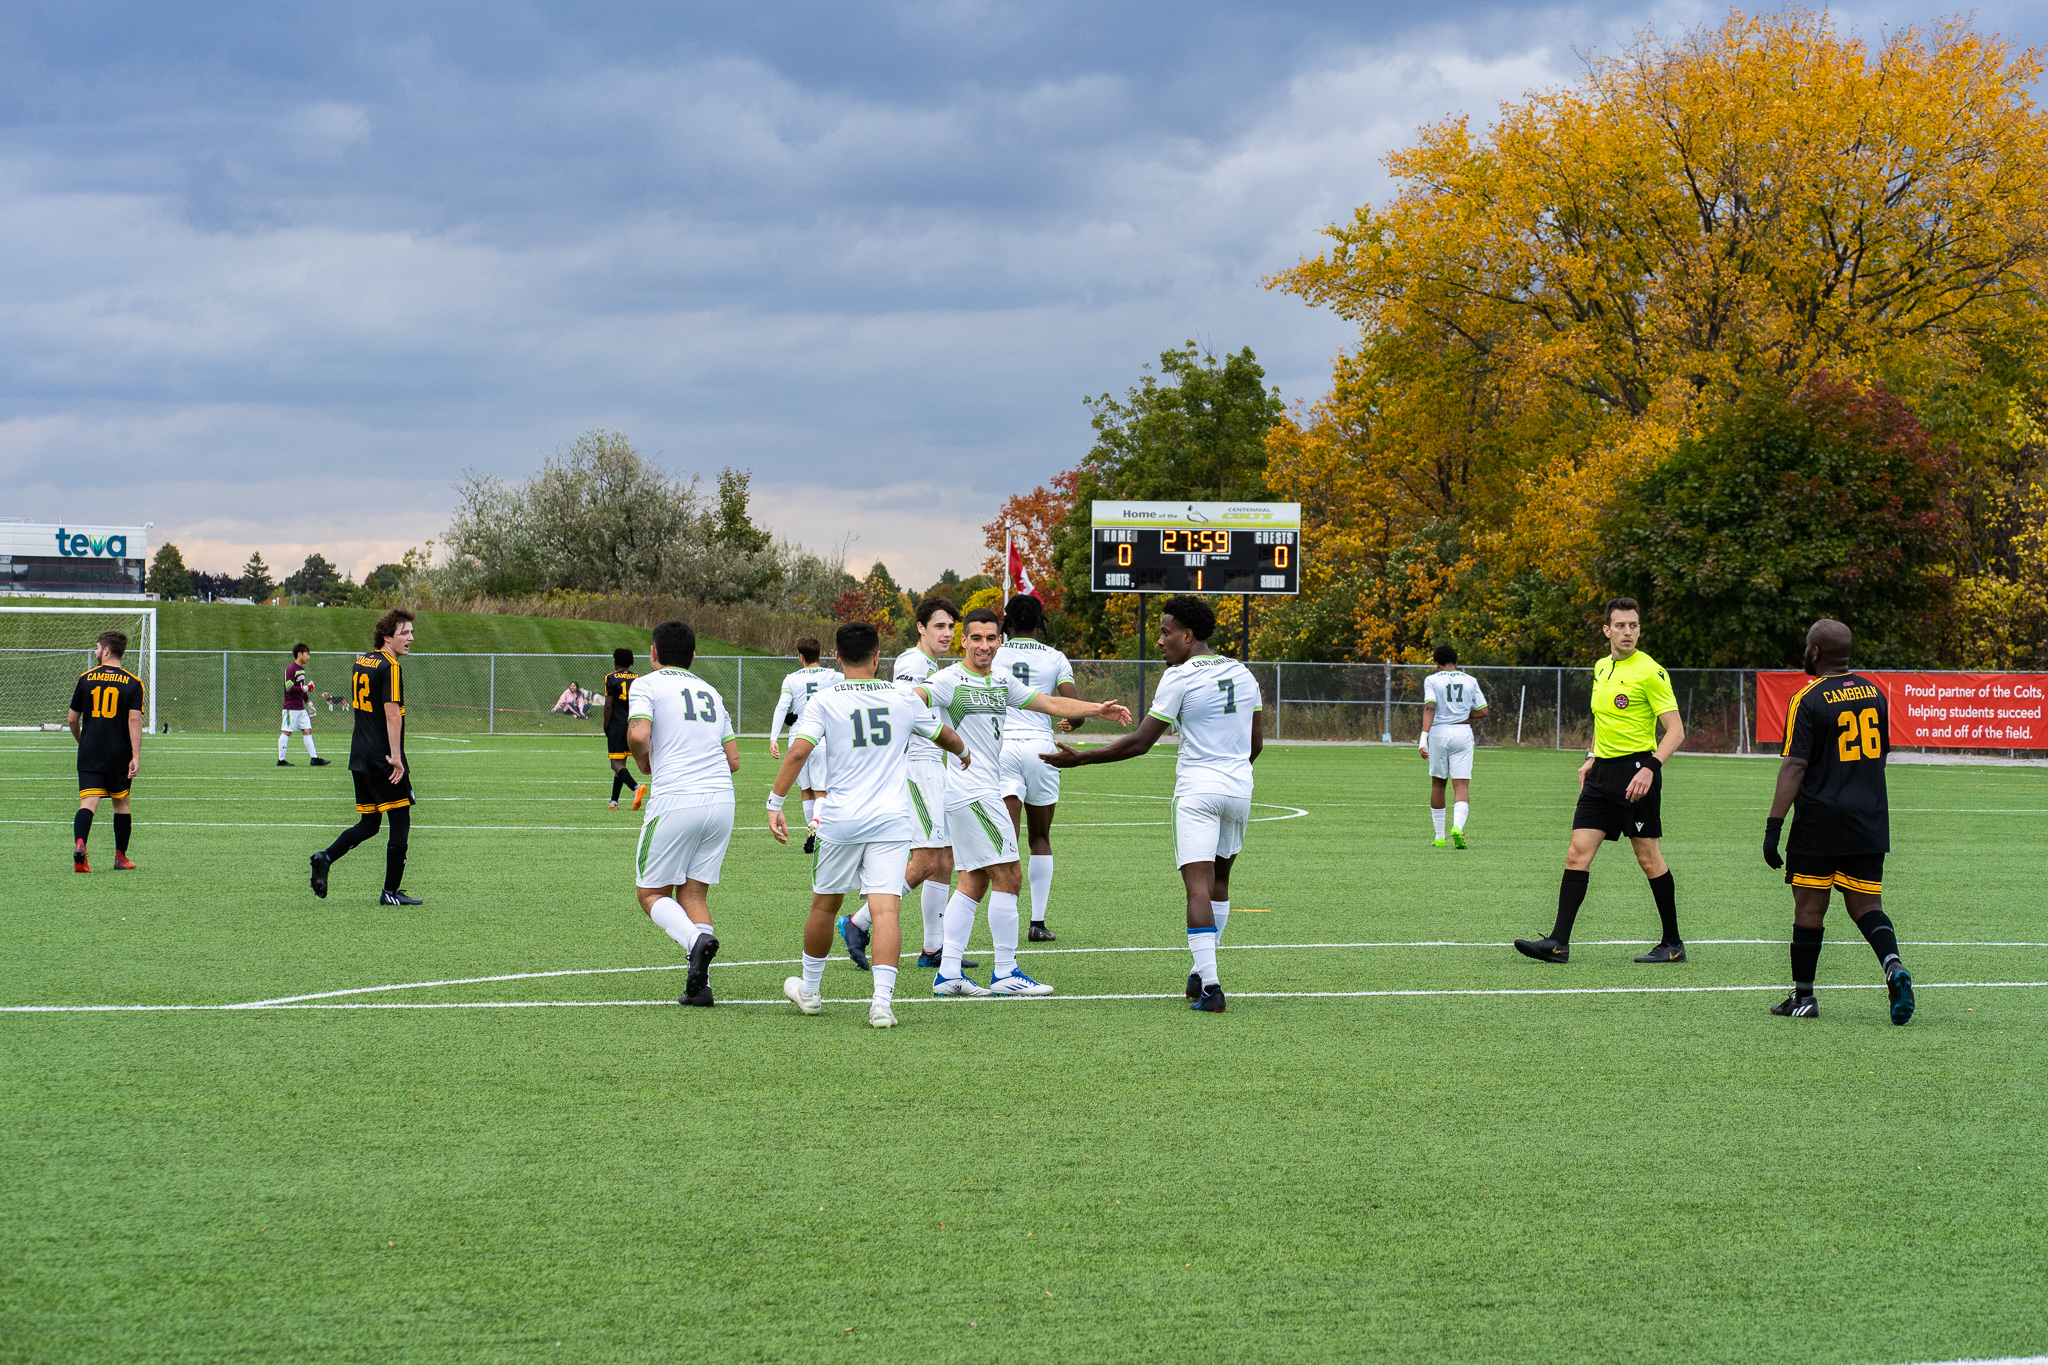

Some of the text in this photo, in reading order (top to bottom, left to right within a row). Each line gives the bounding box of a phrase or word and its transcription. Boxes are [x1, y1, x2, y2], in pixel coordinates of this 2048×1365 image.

[1123, 509, 1157, 519] Home
[1222, 512, 1274, 520] COLTS
[55, 527, 127, 557] teva
[1103, 529, 1132, 543] HOME
[1163, 530, 1229, 553] 27:59
[1255, 531, 1294, 545] GUESTS
[1118, 543, 1132, 566] 0
[1184, 554, 1206, 567] HALF
[1274, 545, 1289, 568] 0
[1105, 573, 1130, 586] SHOTS
[1197, 569, 1203, 590] 1
[1260, 574, 1286, 588] SHOTS
[86, 672, 130, 684] CAMBRIAN
[1012, 662, 1030, 687] 9
[352, 671, 373, 713] 12
[834, 682, 896, 692] CENTENNIAL
[1217, 678, 1237, 715] 7
[1445, 683, 1464, 703] 17
[1823, 685, 1879, 704] CAMBRIAN
[1904, 683, 2045, 701] Proud partner of the Colts,
[90, 685, 120, 719] 10
[680, 687, 717, 723] 13
[1908, 703, 2042, 722] helping students succeed
[849, 706, 892, 749] 15
[990, 716, 1001, 741] 3
[1837, 707, 1882, 762] 26
[1915, 724, 2033, 740] on and off of the field.
